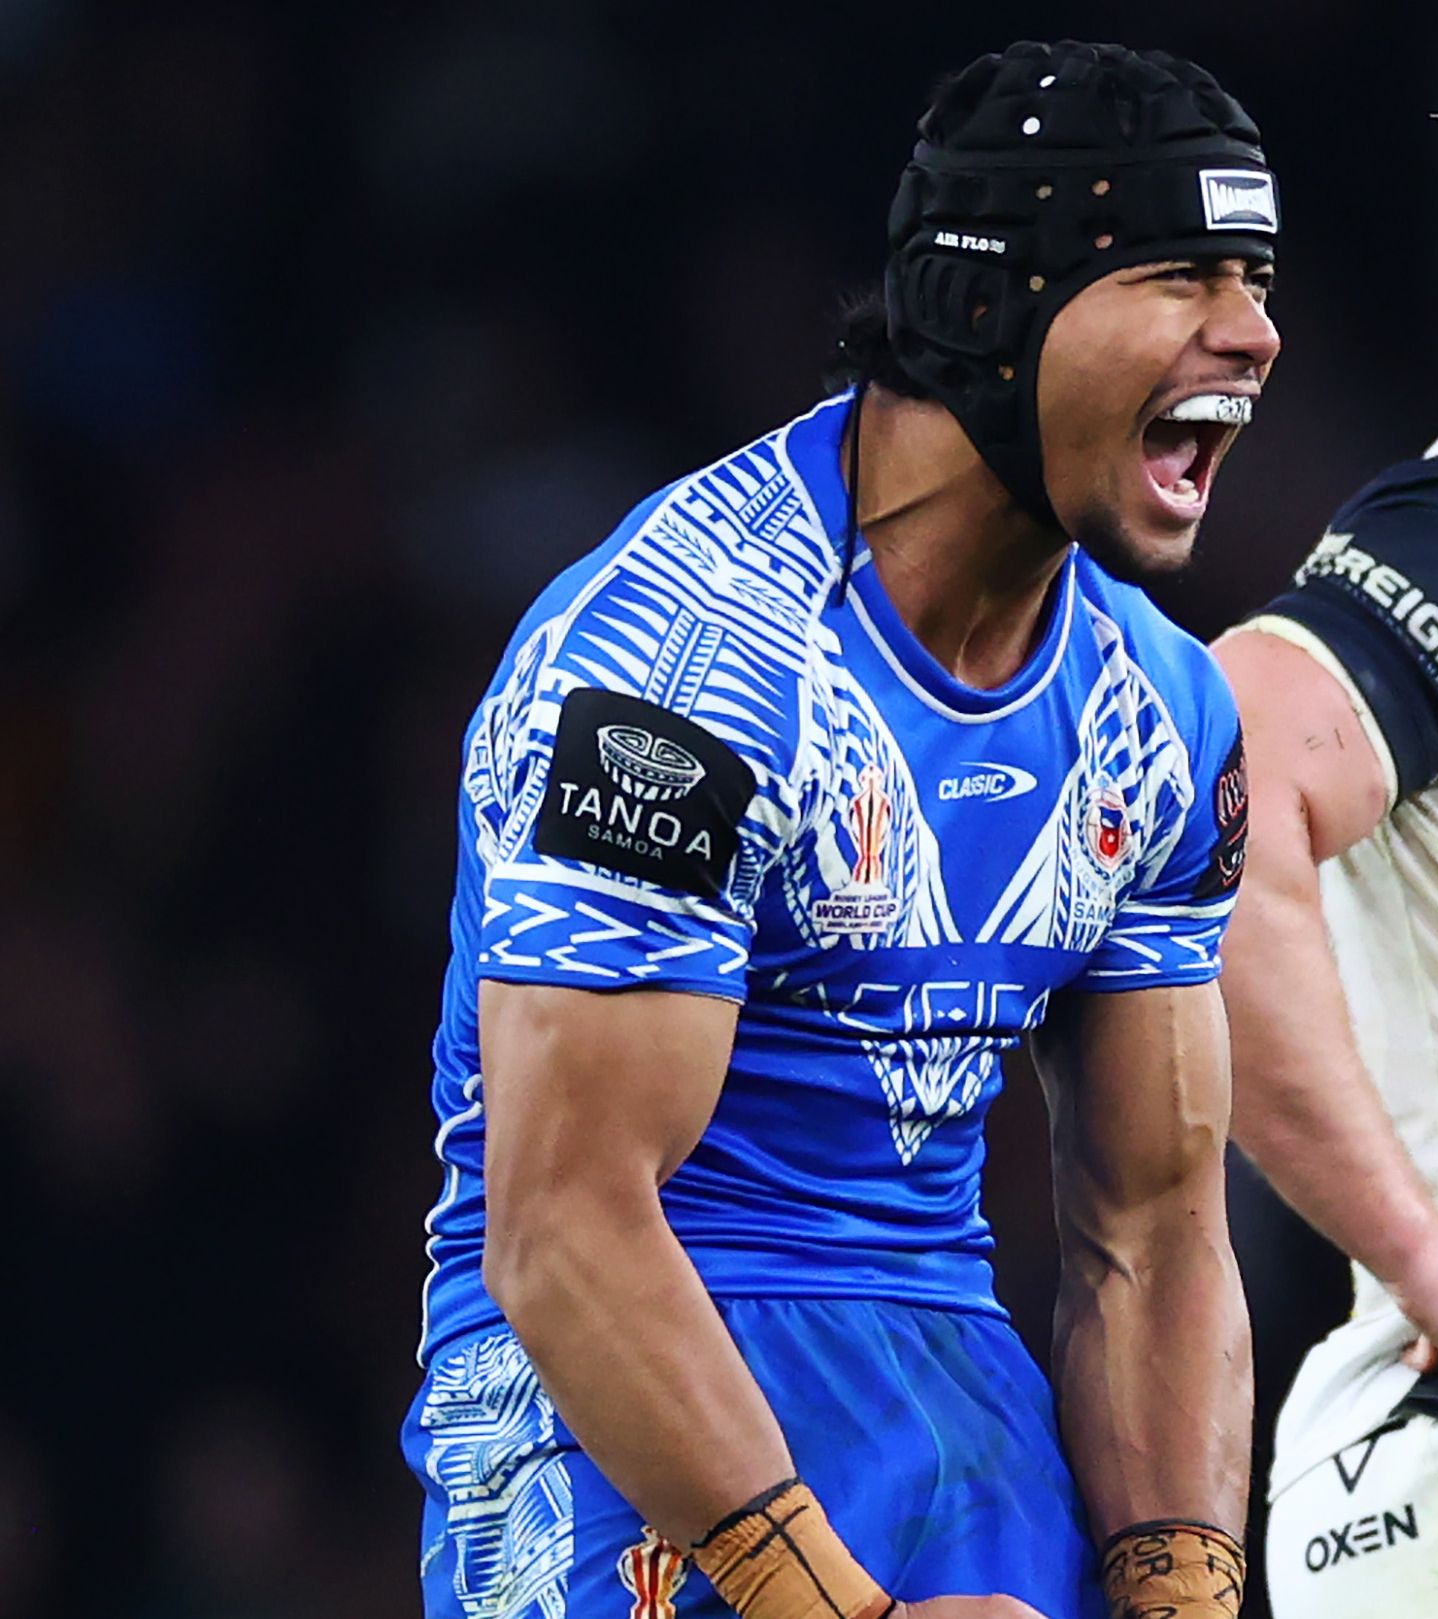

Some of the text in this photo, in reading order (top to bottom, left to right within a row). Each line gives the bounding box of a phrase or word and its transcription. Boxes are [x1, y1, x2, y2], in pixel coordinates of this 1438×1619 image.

[933, 231, 959, 248] AIR
[559, 782, 712, 861] TANOA
[587, 823, 664, 861] SAMOA
[816, 903, 897, 919] WORLD CUP
[1305, 1503, 1419, 1573] OXEN
